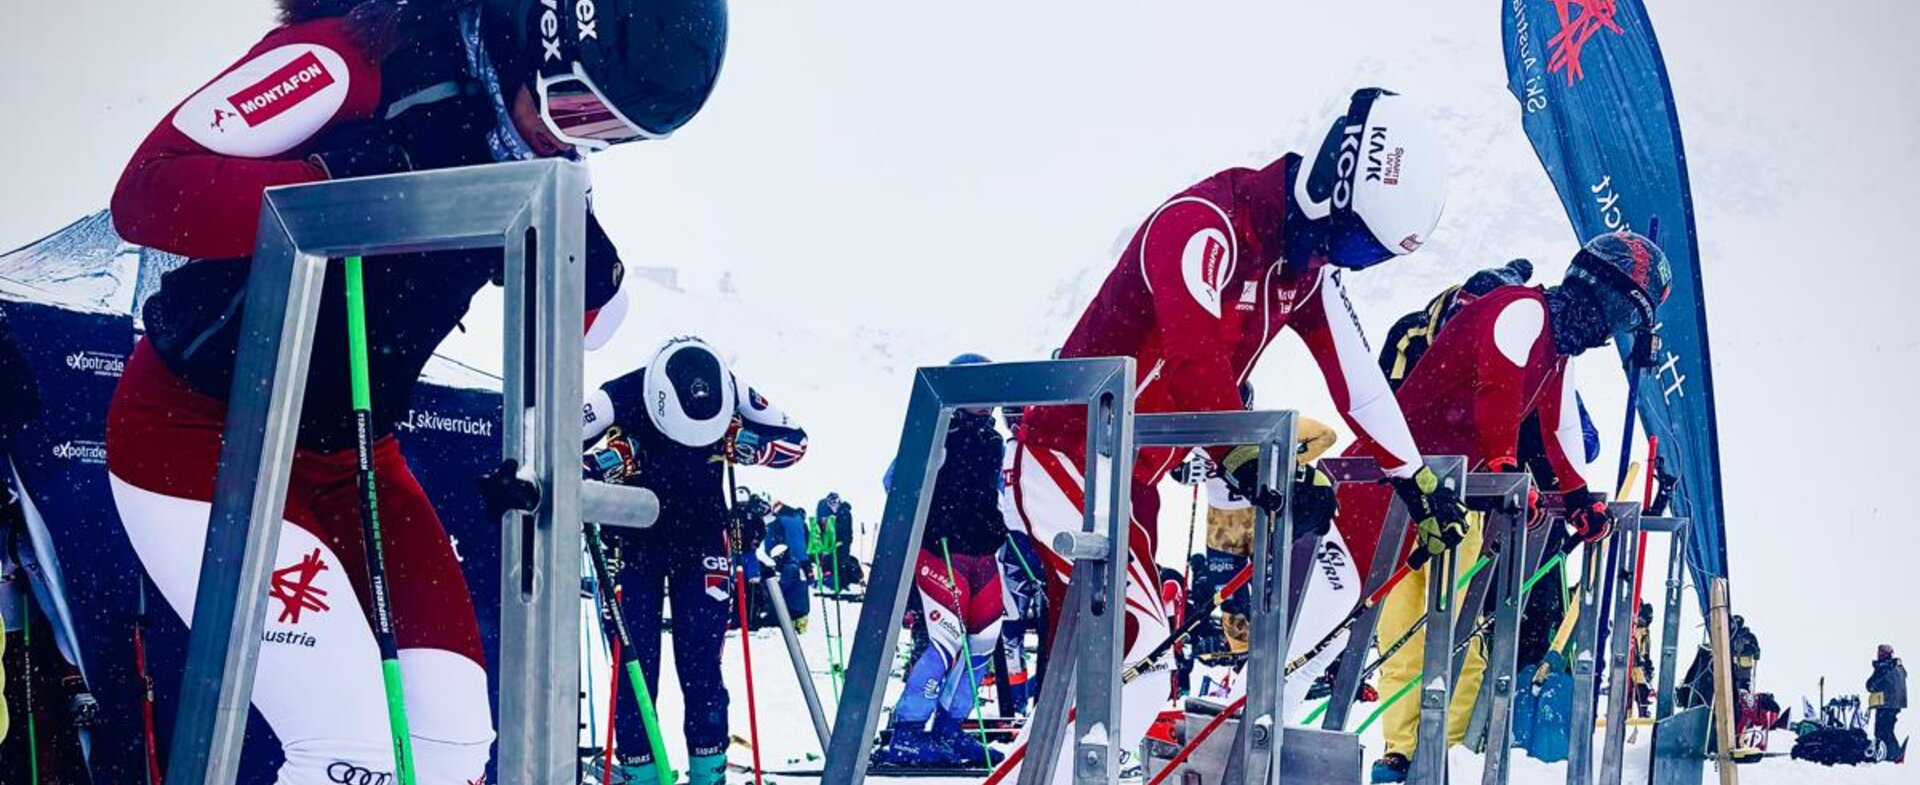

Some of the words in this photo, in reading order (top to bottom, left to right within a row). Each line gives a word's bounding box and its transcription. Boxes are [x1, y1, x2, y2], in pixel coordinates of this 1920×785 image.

[240, 63, 322, 114] MONTAFON
[416, 410, 492, 437] skiverrückt
[260, 630, 317, 648] ustria
